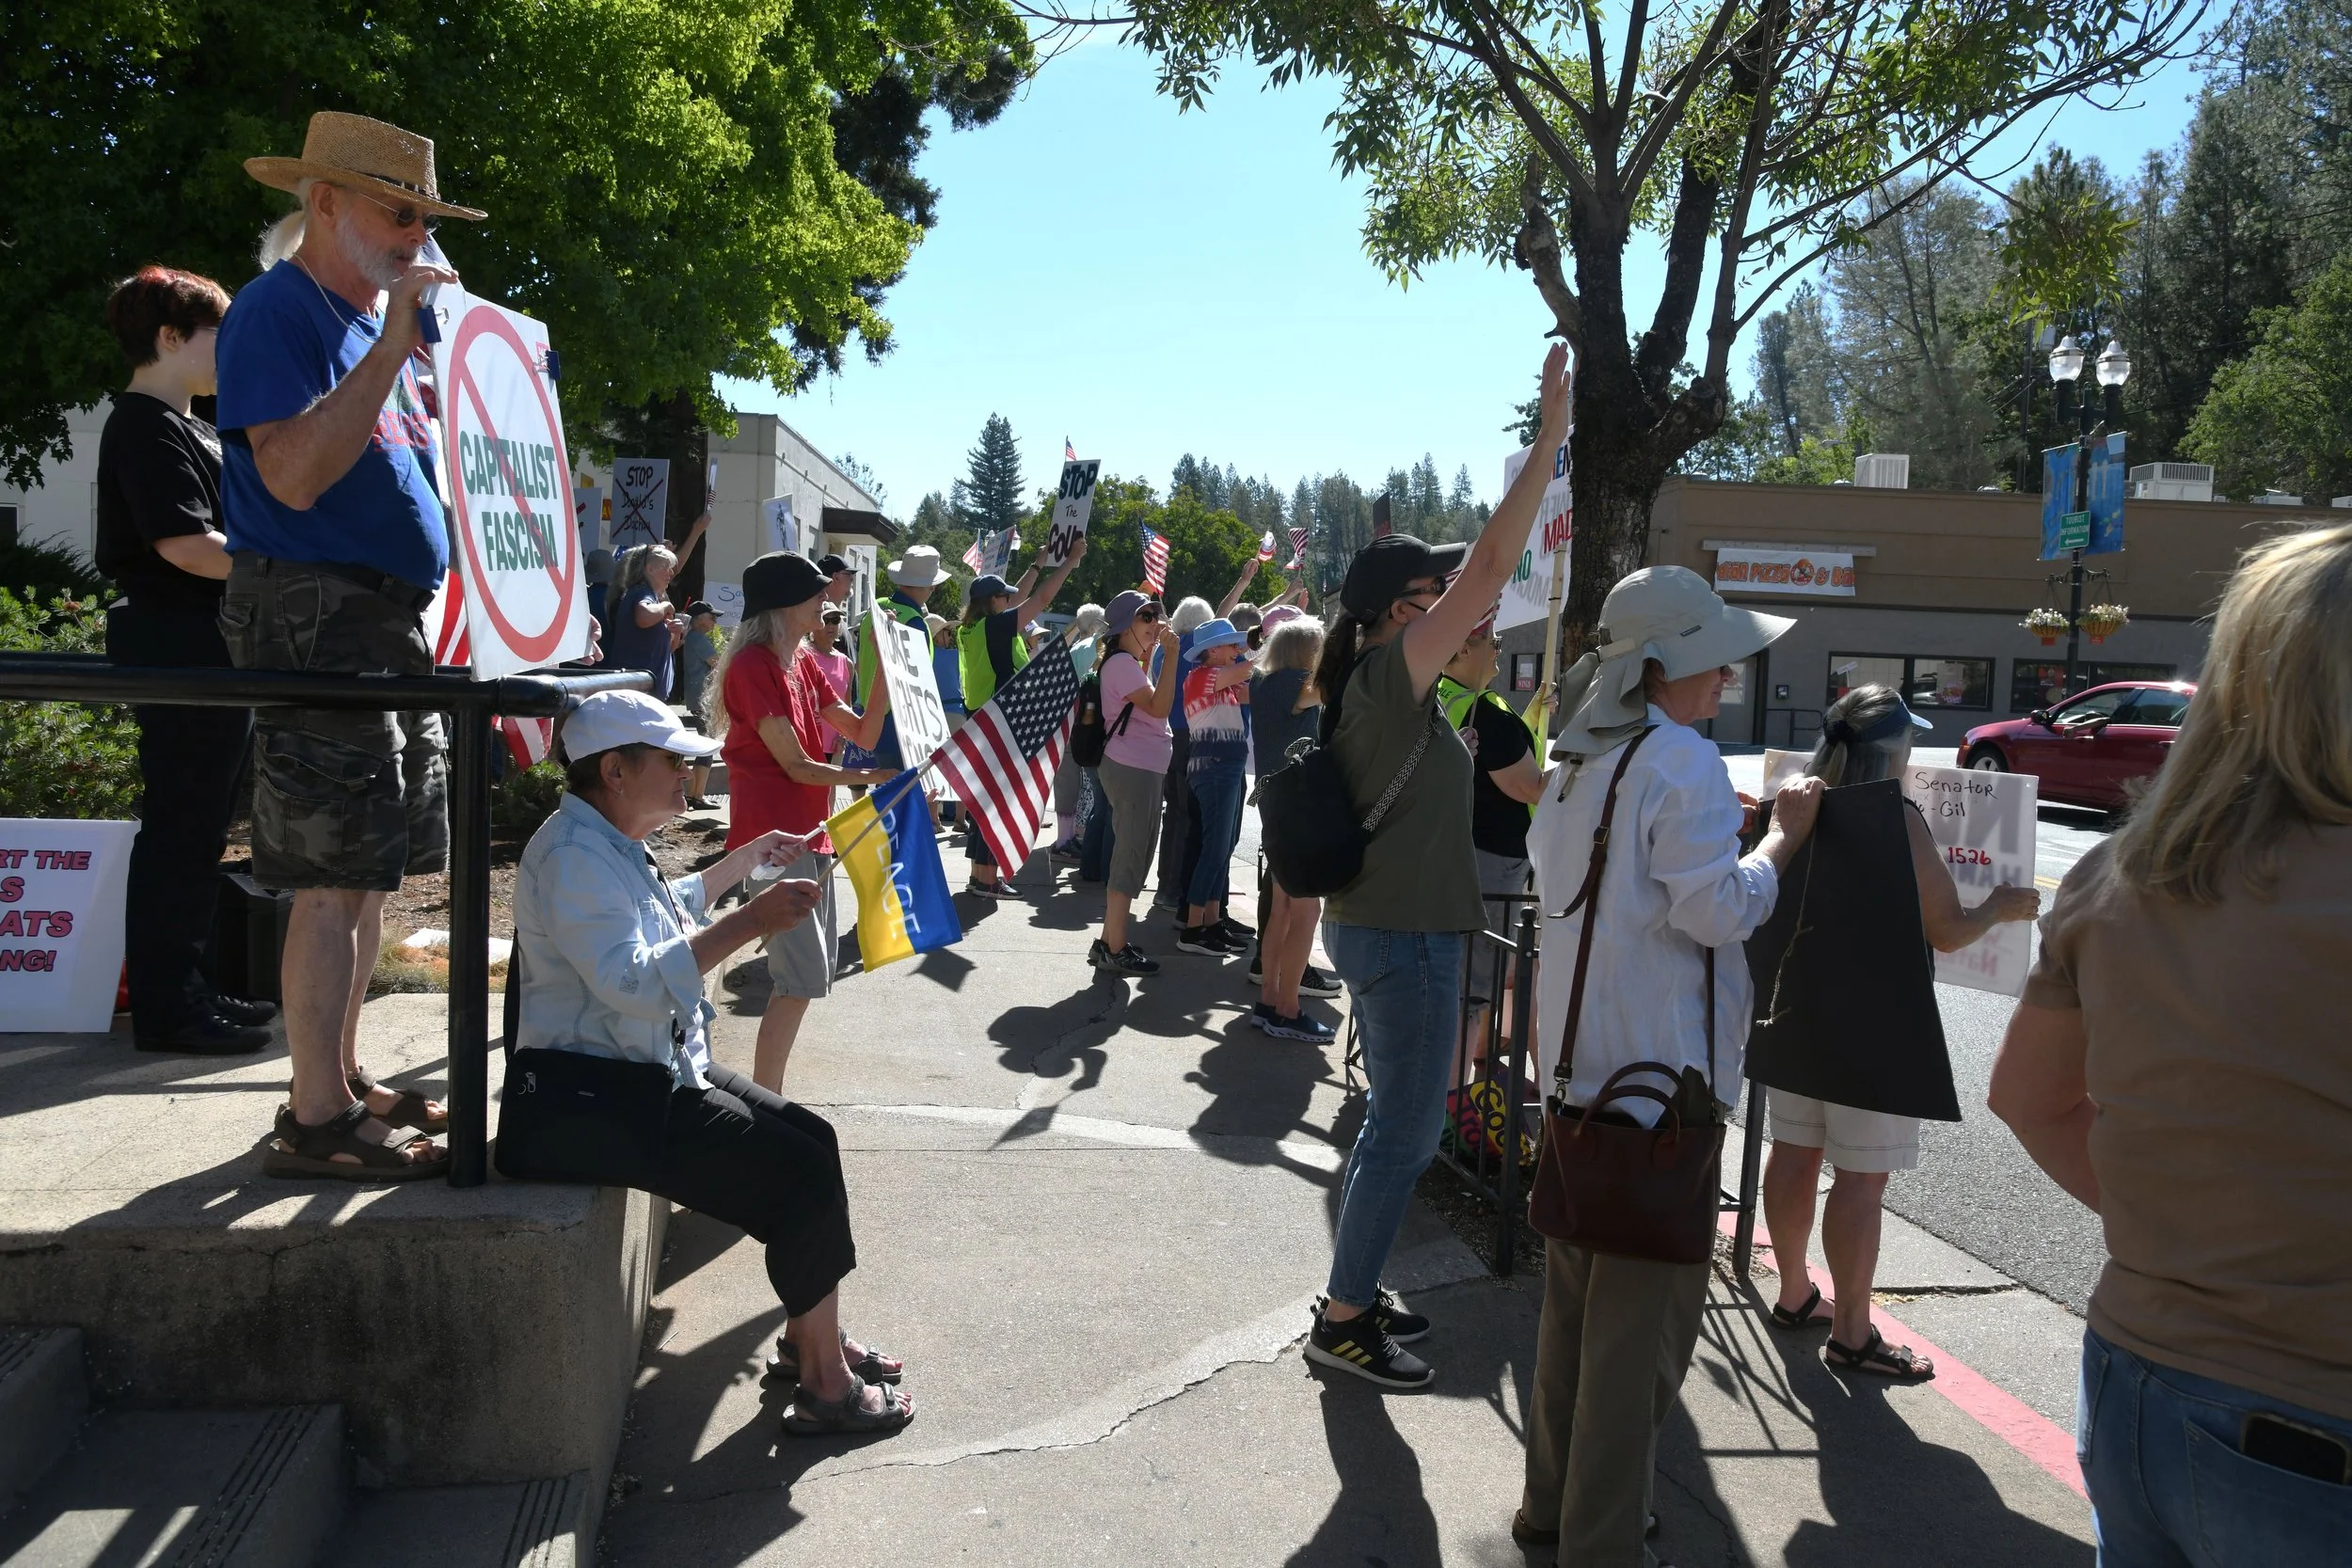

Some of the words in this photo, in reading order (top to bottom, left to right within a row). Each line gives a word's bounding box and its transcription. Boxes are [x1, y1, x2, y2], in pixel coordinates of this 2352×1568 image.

[459, 430, 558, 500] CAPITALIST
[626, 466, 654, 489] STOP
[1058, 462, 1099, 500] STOP
[1065, 504, 1078, 518] The
[482, 510, 559, 572] FASCISM
[34, 850, 91, 870] THE
[1947, 846, 1992, 865] 1526
